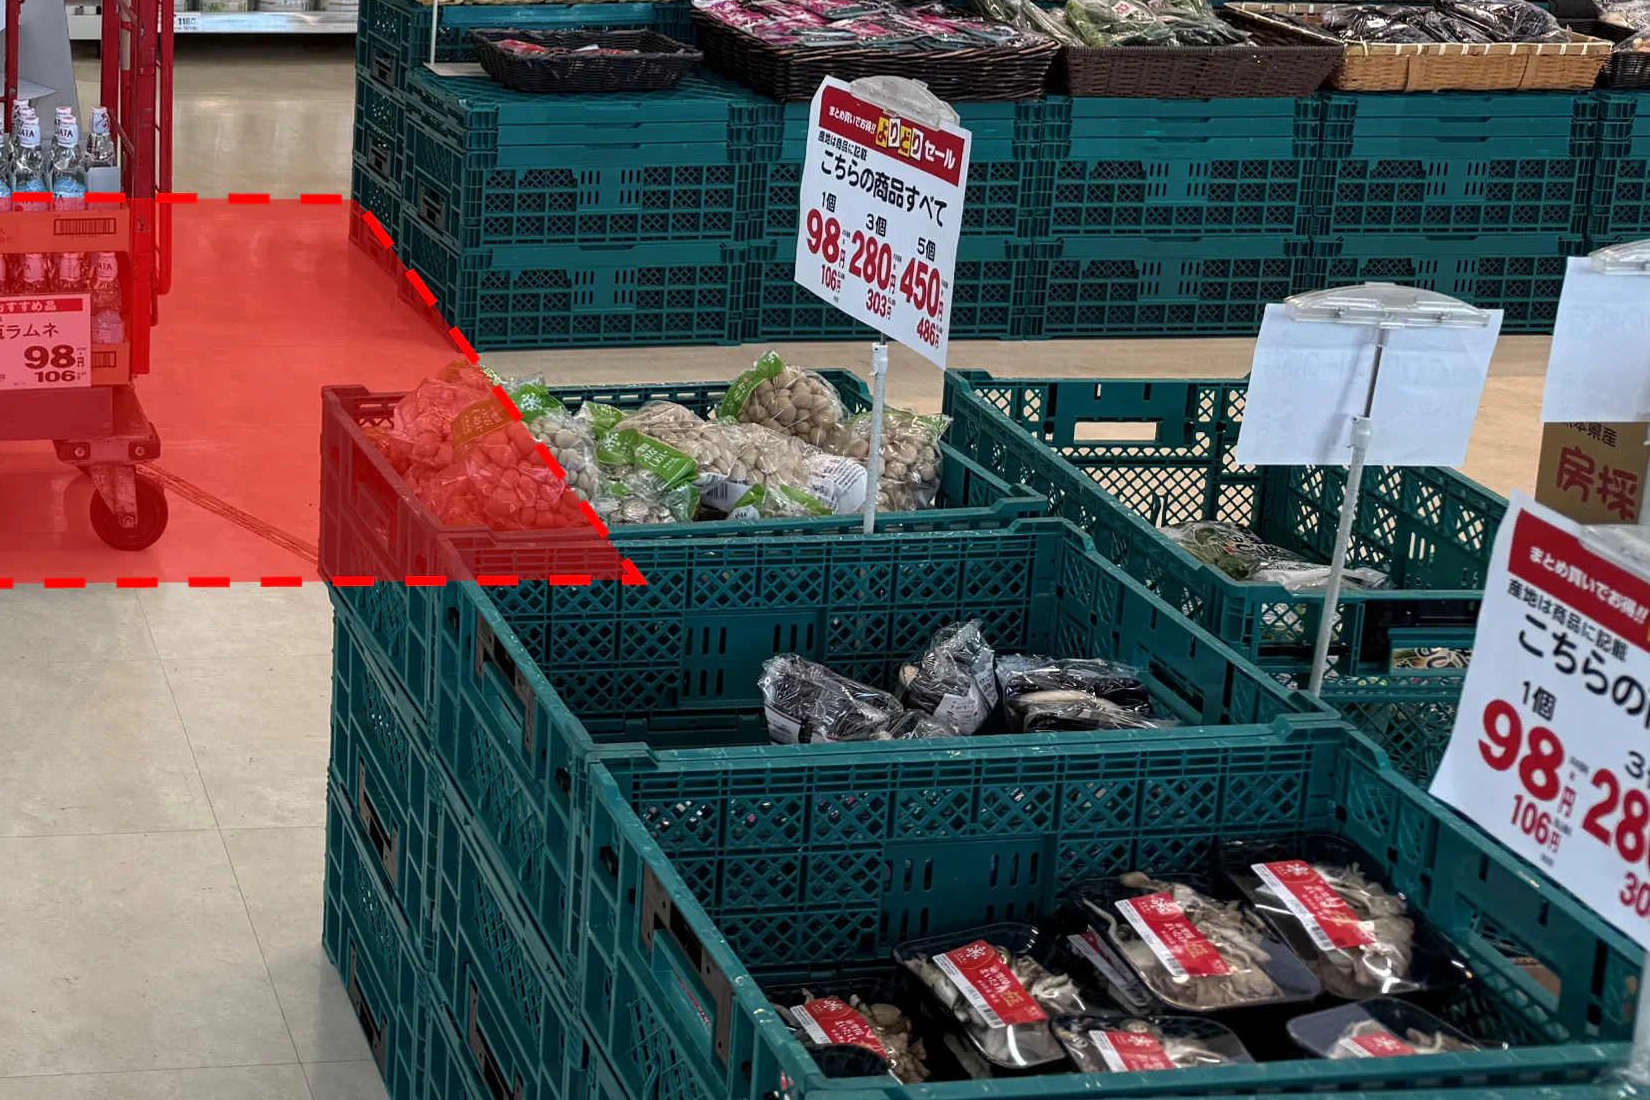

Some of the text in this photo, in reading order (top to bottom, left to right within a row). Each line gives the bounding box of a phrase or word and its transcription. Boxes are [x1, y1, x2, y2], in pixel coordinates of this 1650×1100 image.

[821, 150, 947, 227] こちらの商品すべて
[822, 191, 836, 213] 1個
[807, 209, 840, 263] 98
[866, 214, 886, 236] 3個
[849, 230, 892, 291] 280
[917, 239, 936, 261] 5個
[821, 264, 836, 288] 106
[901, 257, 939, 317] 450
[866, 288, 887, 317] 303
[917, 318, 935, 348] 486
[24, 344, 76, 369] 98
[35, 371, 75, 382] 106
[1564, 422, 1618, 447] 本県産
[1507, 579, 1628, 661] 産地は商品に記載
[1518, 614, 1650, 726] こちらの
[1521, 681, 1556, 722] 1個
[1478, 700, 1564, 800] 98
[1510, 794, 1549, 845] 106
[1582, 769, 1650, 864] 28
